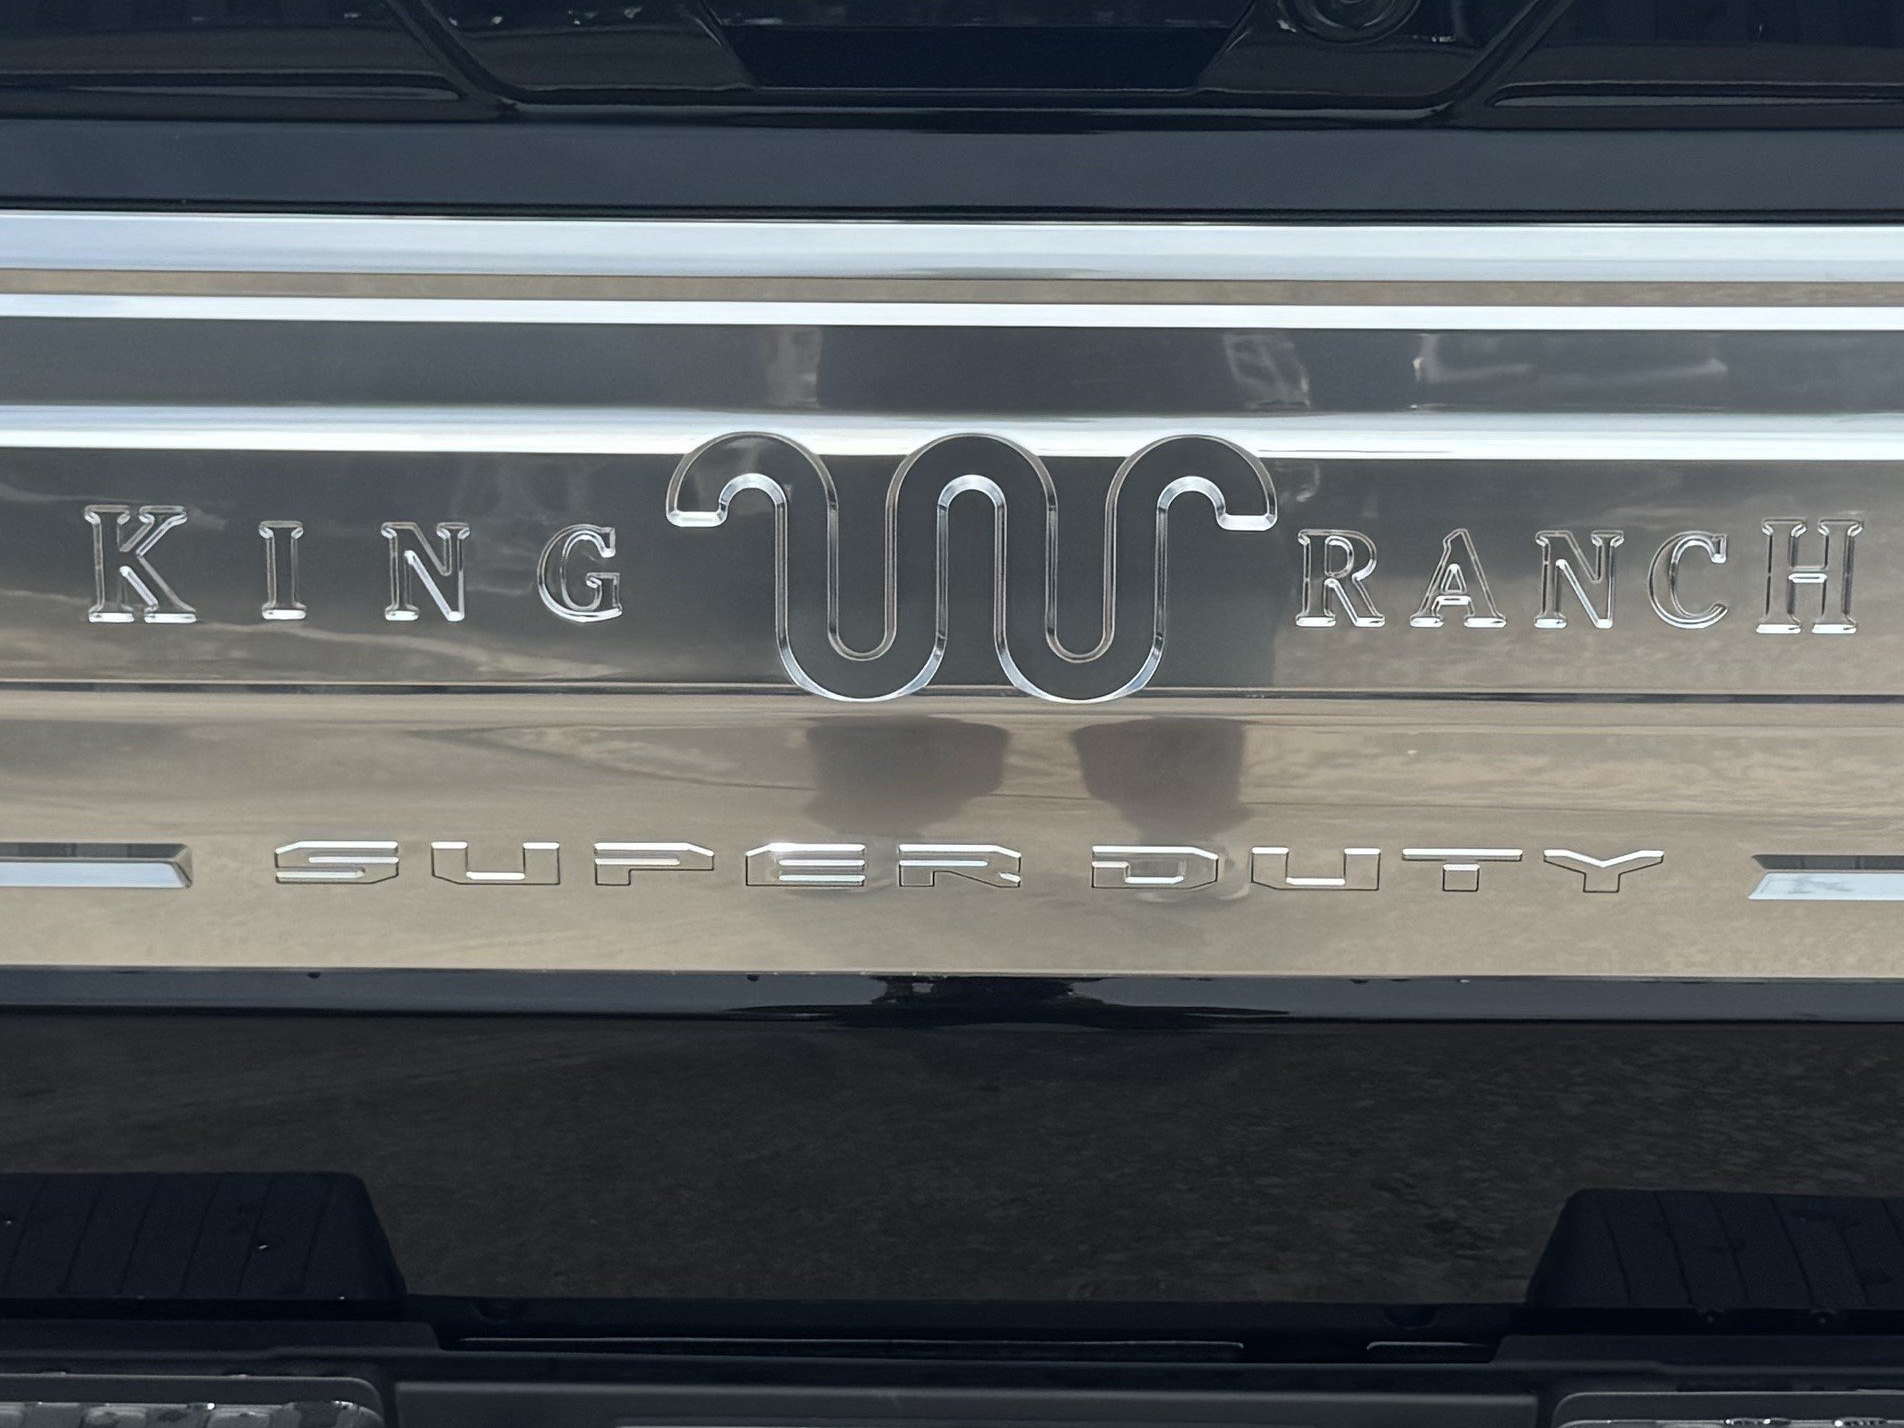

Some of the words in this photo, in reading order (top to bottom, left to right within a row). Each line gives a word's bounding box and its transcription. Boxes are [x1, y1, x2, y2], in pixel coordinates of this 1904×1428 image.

[84, 504, 623, 624] KING
[1296, 517, 1864, 634] RANCH
[275, 840, 1021, 888] SUPER
[1092, 845, 1664, 893] DUTY
